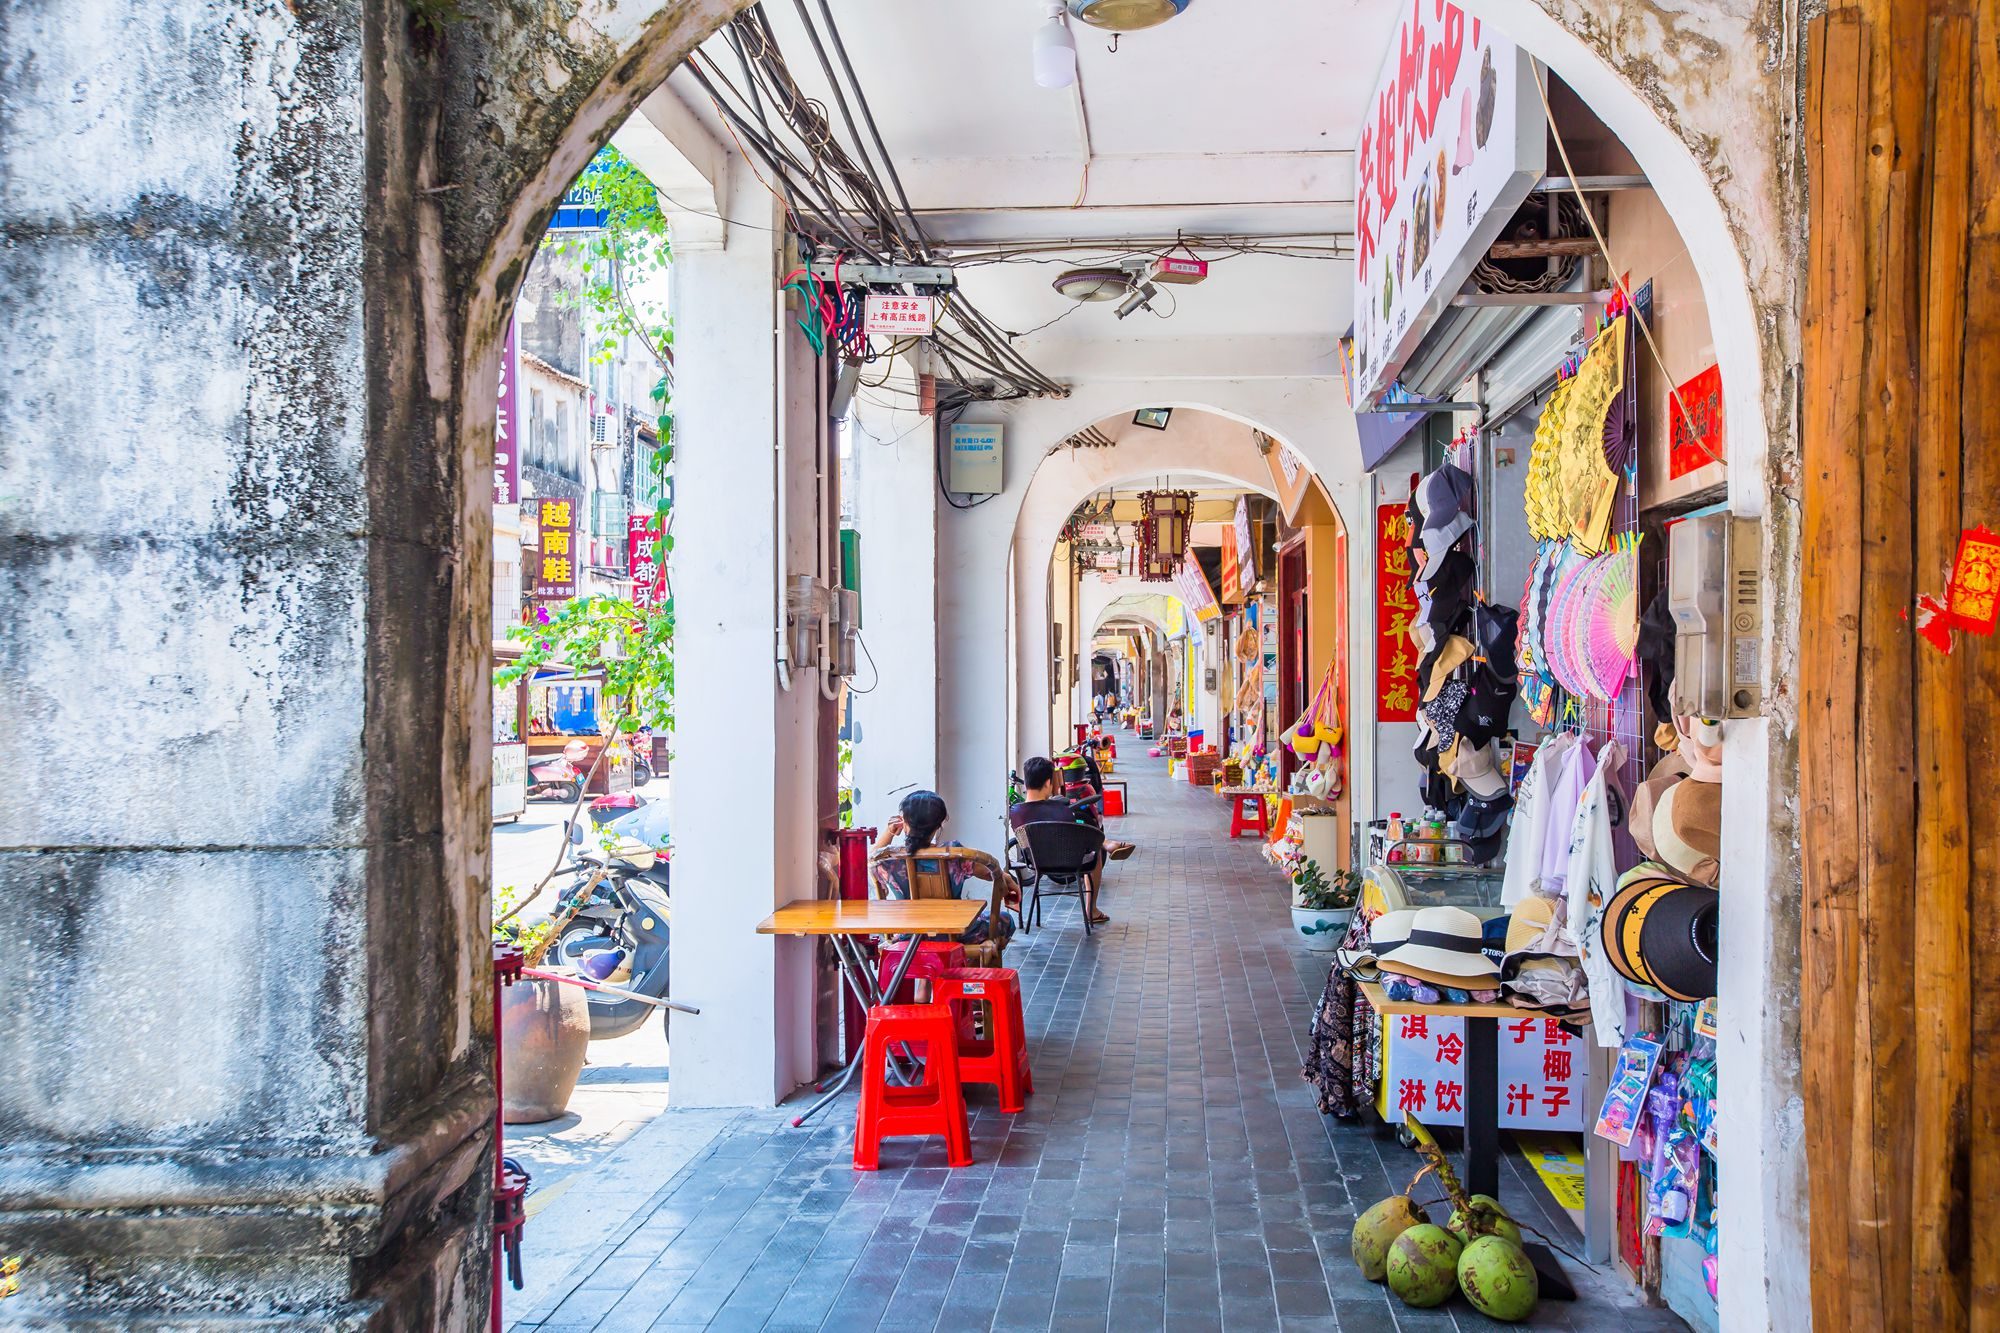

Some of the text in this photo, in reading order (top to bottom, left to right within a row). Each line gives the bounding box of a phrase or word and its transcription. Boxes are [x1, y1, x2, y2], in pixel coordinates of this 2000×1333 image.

[1358, 0, 1480, 286] 荣姐饮品
[563, 187, 604, 203] 126店
[870, 312, 926, 322] 上有高压线路
[881, 301, 919, 311] 注意安全
[541, 501, 572, 583] 越南鞋
[633, 536, 659, 630] 成都采
[1398, 1015, 1428, 1112] 淇淋
[1435, 1016, 1464, 1114] 冷饮
[1506, 1017, 1536, 1117] 子汁
